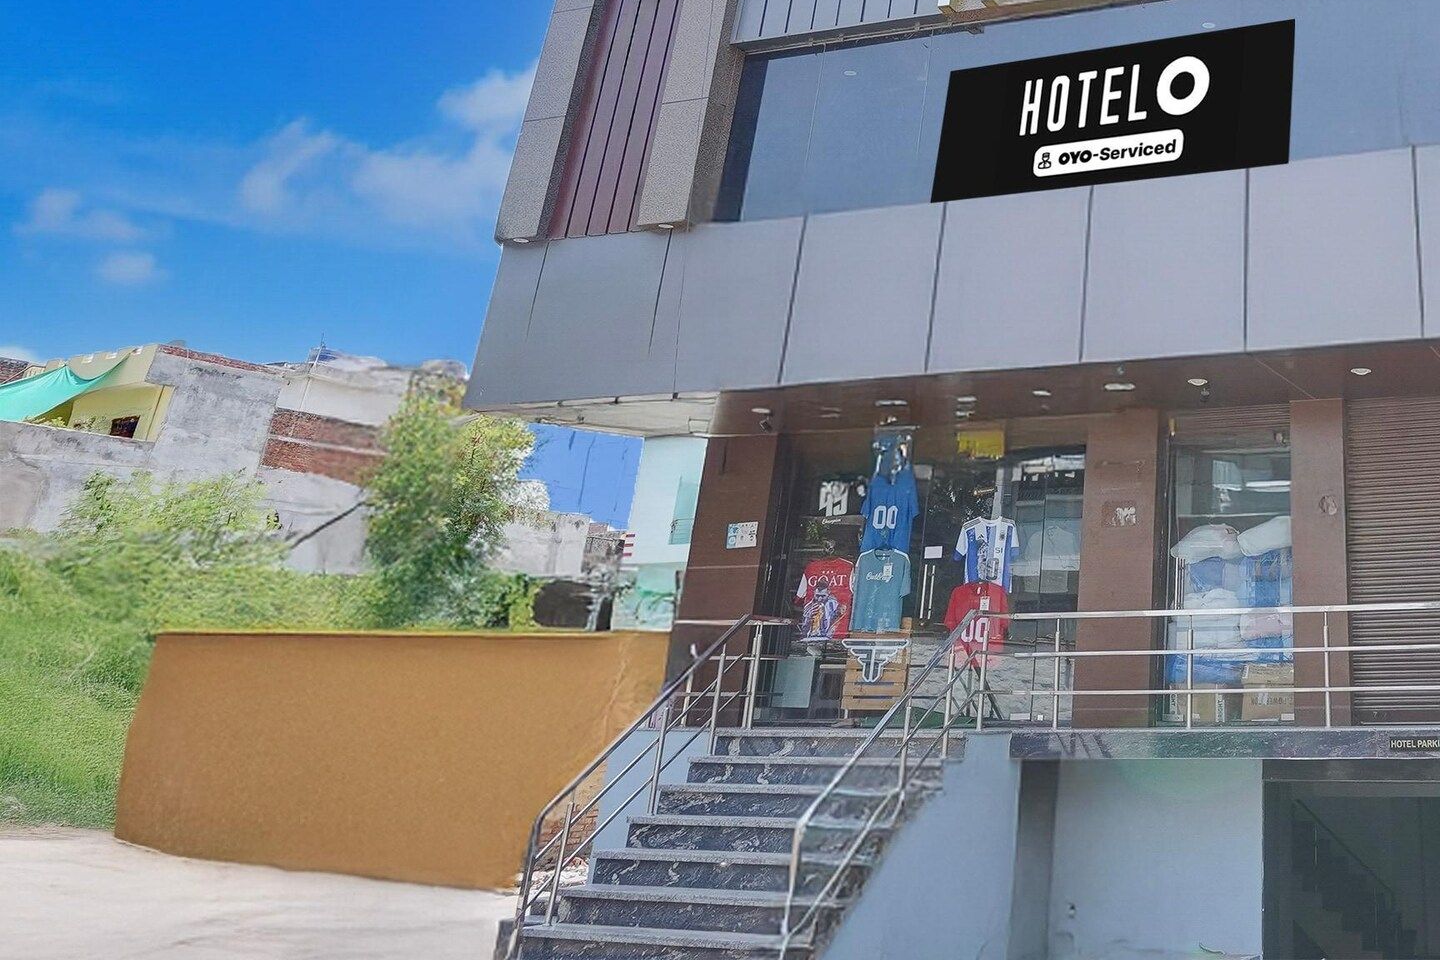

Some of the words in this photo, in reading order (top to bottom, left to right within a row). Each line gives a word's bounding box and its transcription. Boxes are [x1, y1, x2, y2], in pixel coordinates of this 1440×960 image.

[1019, 64, 1147, 136] HOTEL
[1156, 56, 1210, 116] O
[872, 505, 898, 529] 00
[1390, 739, 1416, 748] HOTEL
